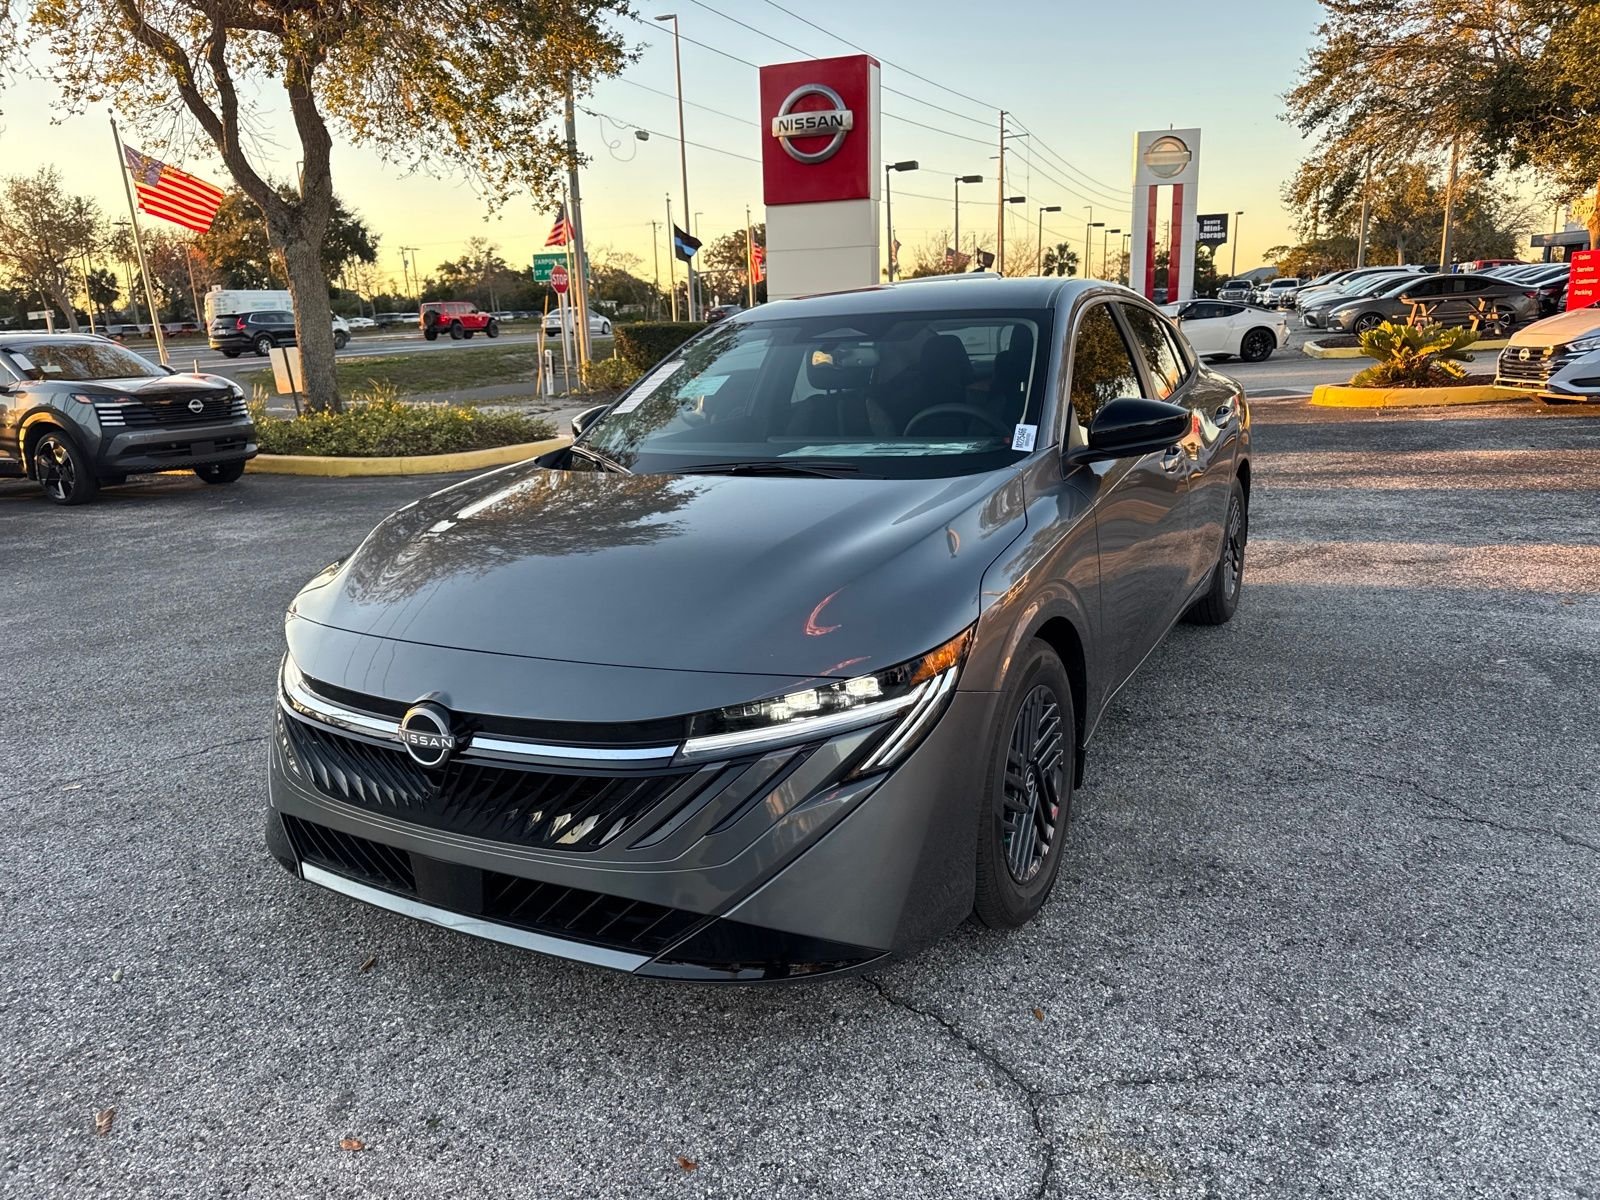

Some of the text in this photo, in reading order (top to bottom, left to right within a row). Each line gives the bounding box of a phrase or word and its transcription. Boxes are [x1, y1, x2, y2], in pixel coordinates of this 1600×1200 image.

[778, 114, 844, 132] NISSAN
[552, 274, 568, 285] STOP
[398, 730, 453, 748] NISSAN
